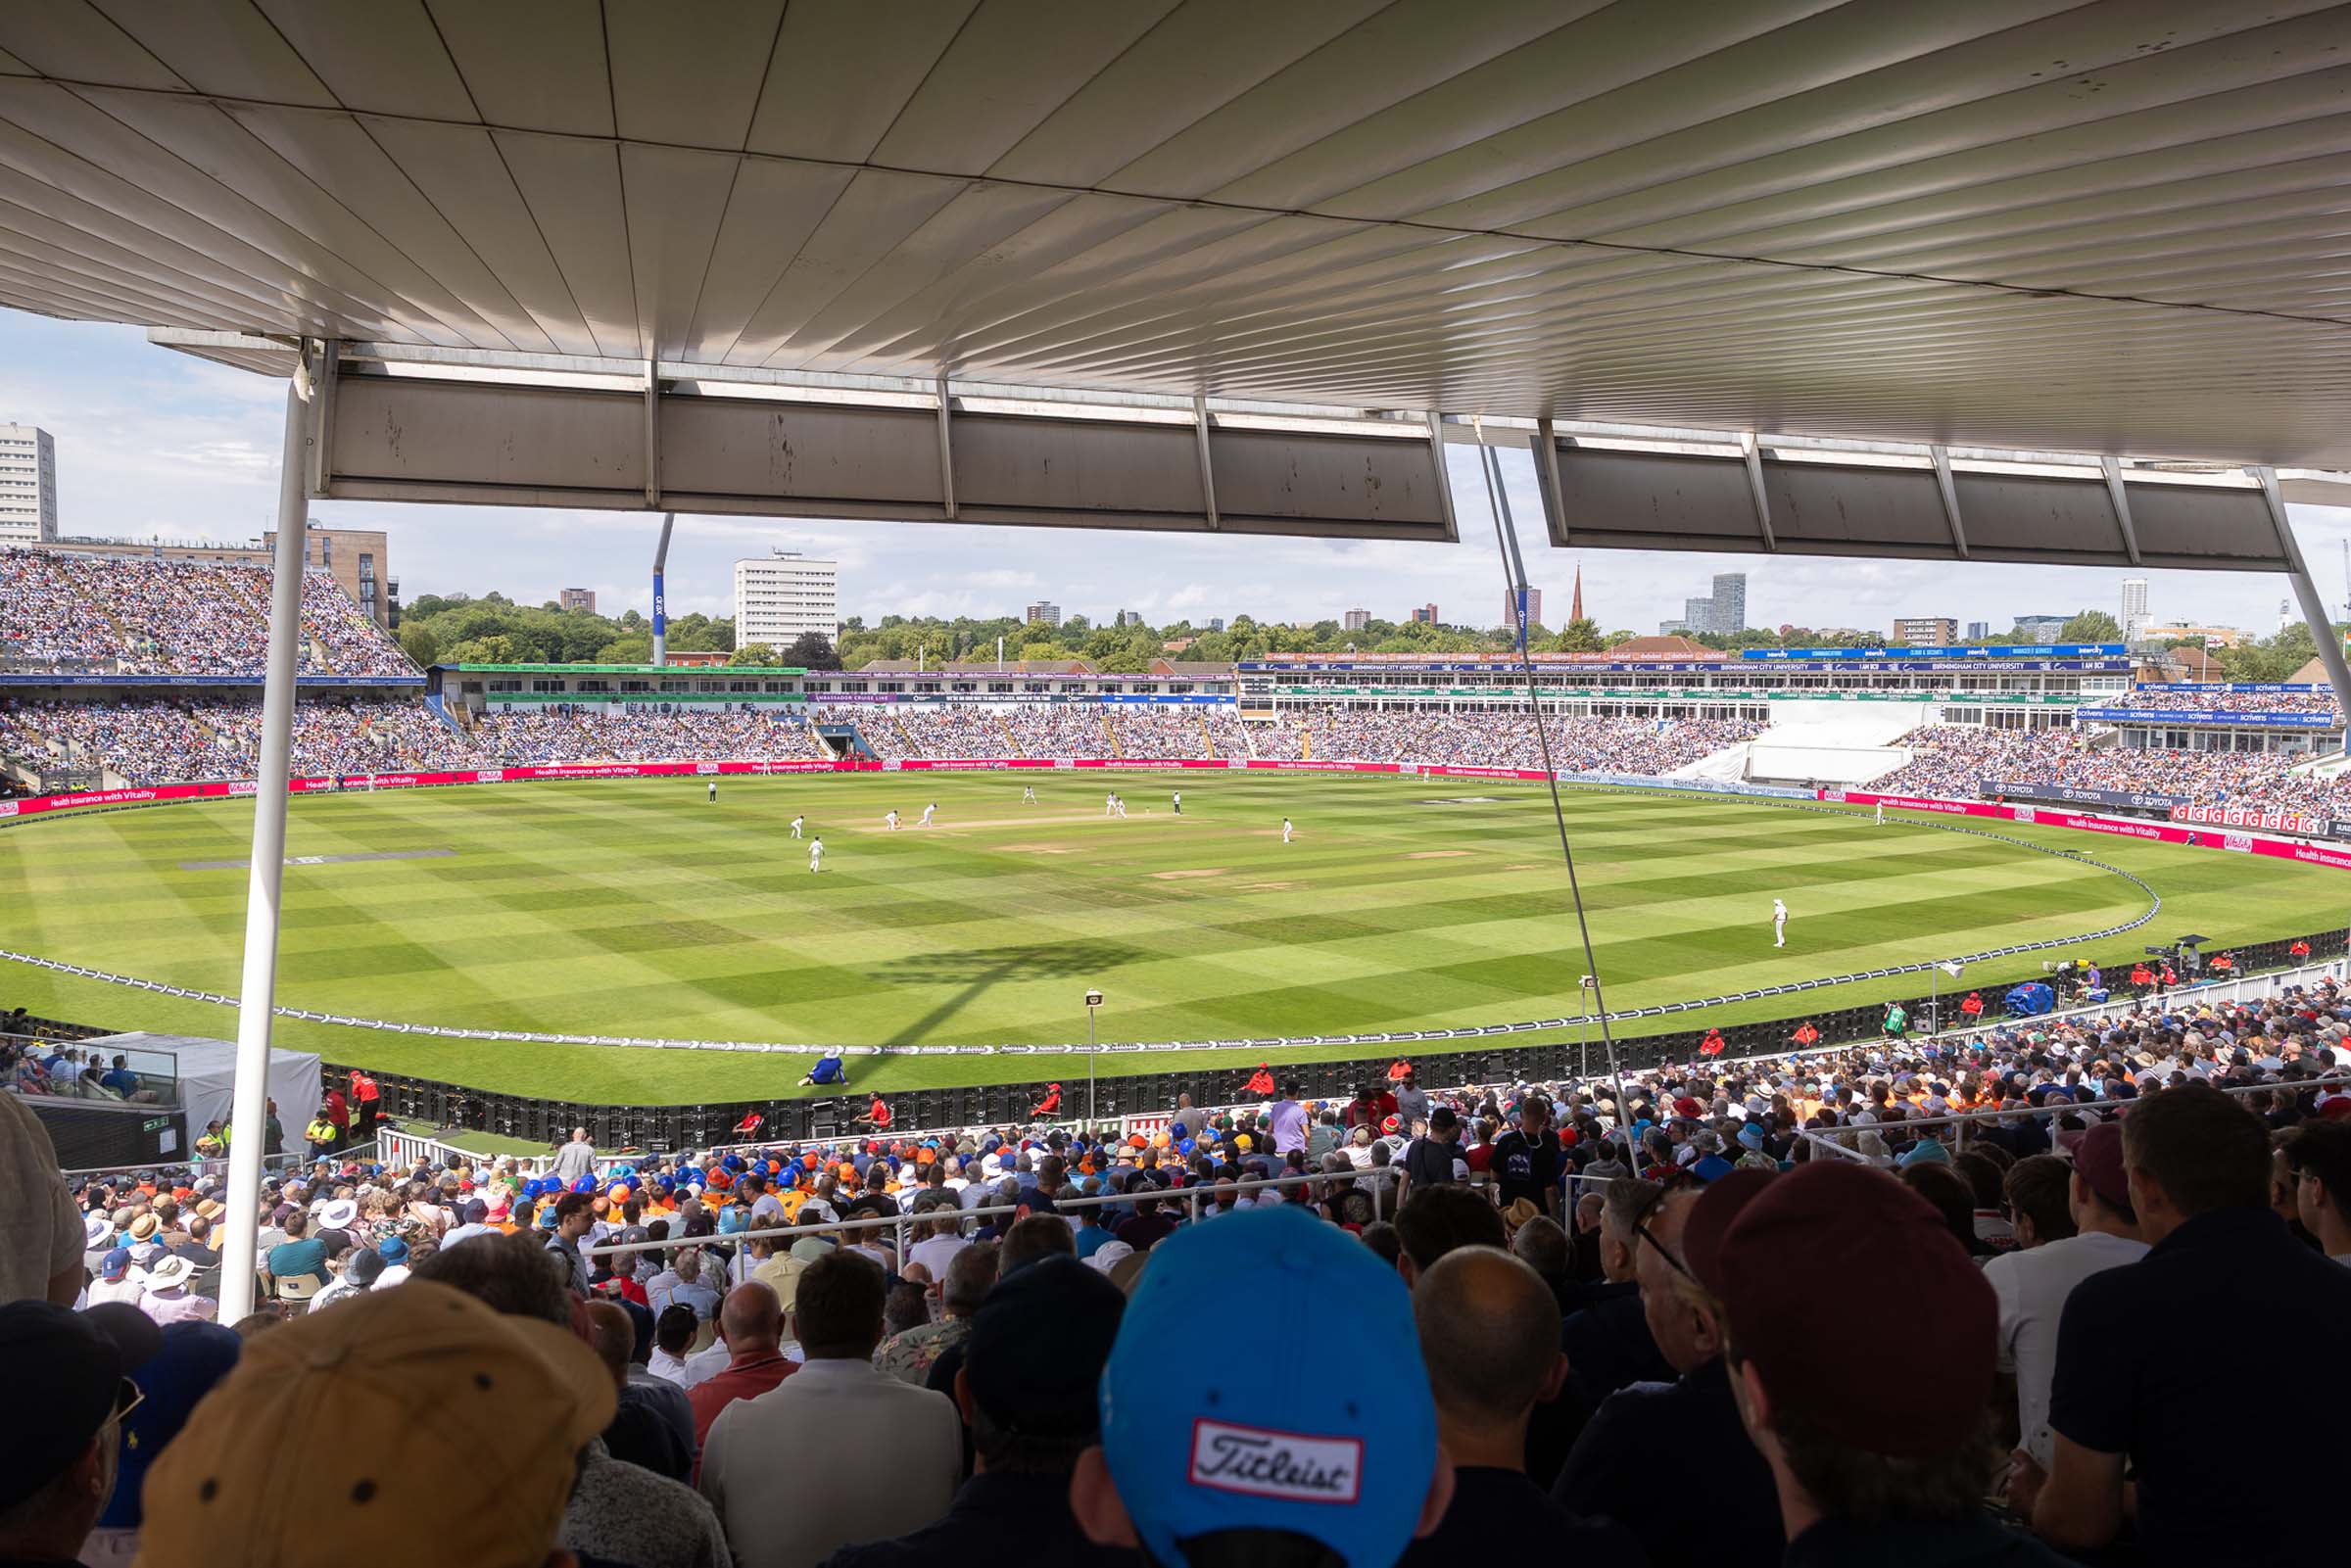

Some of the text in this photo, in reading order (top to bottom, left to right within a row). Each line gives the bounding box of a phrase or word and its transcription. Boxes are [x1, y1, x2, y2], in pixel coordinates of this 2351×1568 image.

[1560, 771, 1601, 784] Rothesay
[1673, 780, 1713, 790] Rothesay
[2008, 785, 2034, 794] TOYOTA
[51, 789, 157, 808] Health insurance with Vitality
[2075, 790, 2101, 800] TOYOTA
[2144, 797, 2172, 807] TOYOTA
[1880, 797, 1899, 806] Health
[1899, 799, 1929, 809] insurance
[1943, 803, 1967, 814] Vitality
[2173, 807, 2185, 819] IG
[2191, 808, 2203, 820] IG
[2209, 809, 2222, 822] IG
[2228, 810, 2240, 824] IG
[2245, 812, 2260, 826] IG
[2067, 817, 2161, 839] Health insurance with Vitality
[2265, 814, 2279, 828] IG
[2283, 815, 2297, 831] IG
[2302, 817, 2313, 832] IG
[2226, 835, 2252, 851] Vitality
[2295, 847, 2351, 867] Health insurance
[1197, 1434, 1350, 1492] Titleist
